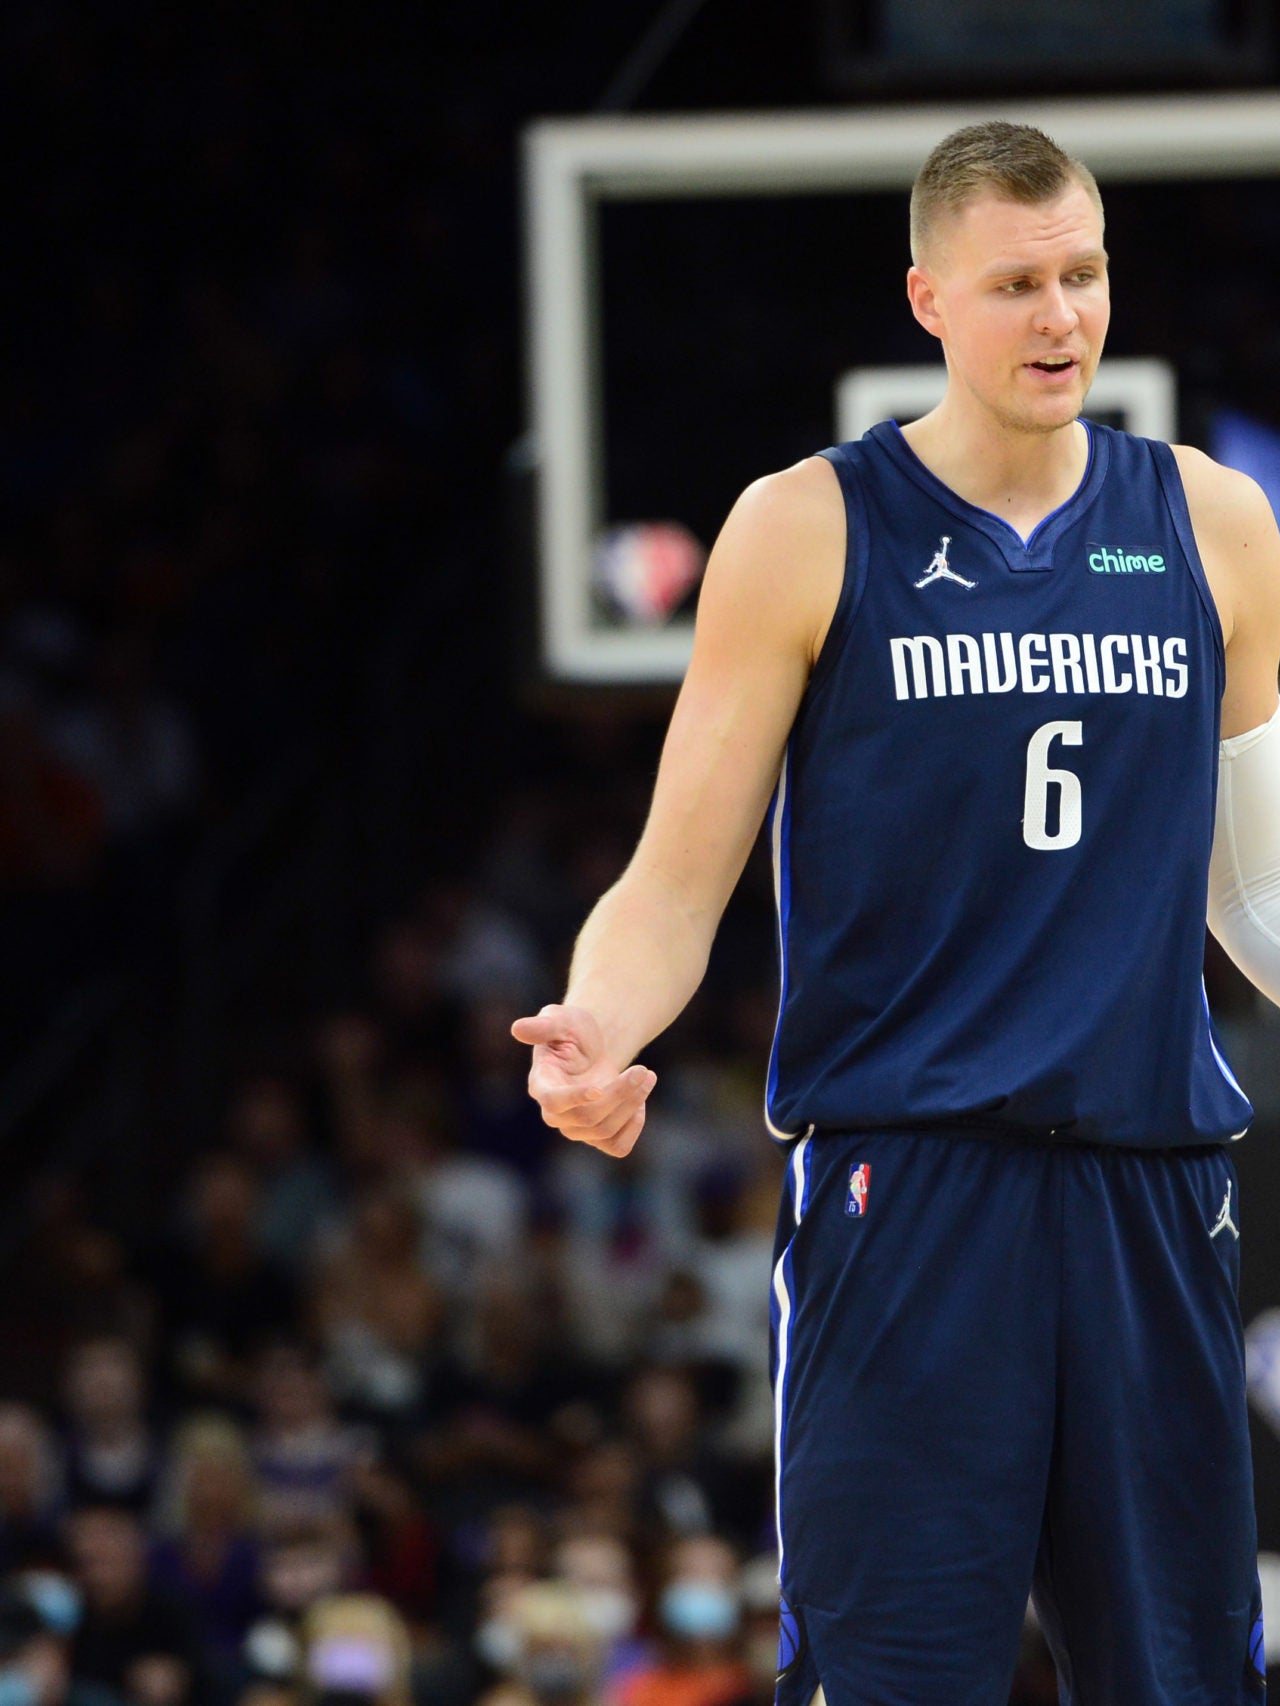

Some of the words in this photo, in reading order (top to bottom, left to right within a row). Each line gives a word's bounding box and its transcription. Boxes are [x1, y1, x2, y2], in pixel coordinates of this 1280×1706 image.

[1089, 547, 1166, 573] chime
[890, 632, 1189, 700] MAVERICKS
[1022, 720, 1084, 851] 6
